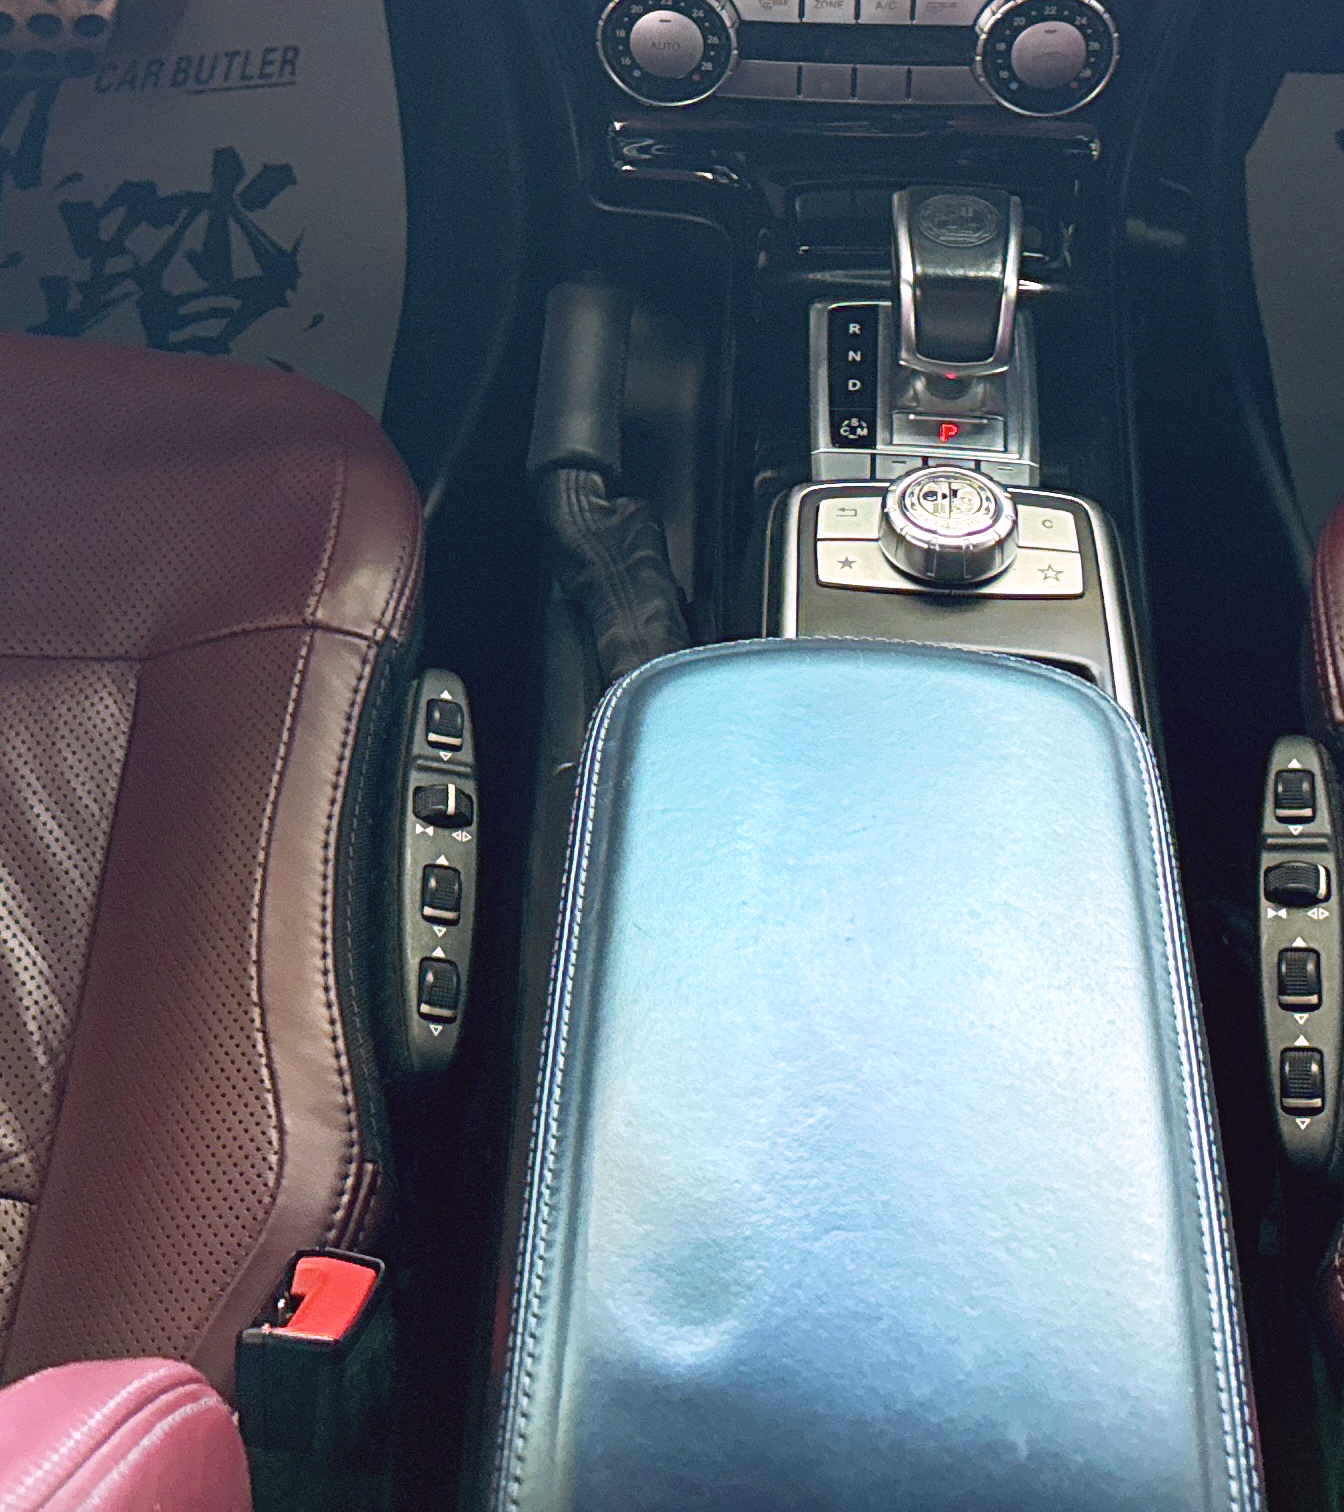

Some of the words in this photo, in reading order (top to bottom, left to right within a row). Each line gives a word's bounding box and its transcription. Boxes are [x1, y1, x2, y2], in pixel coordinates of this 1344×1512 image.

[630, 5, 643, 14] 20
[813, 0, 844, 10] ZONE
[874, 0, 898, 11] A/C
[691, 9, 705, 17] 24
[95, 58, 164, 93] CAR
[170, 44, 301, 91] BUTLER
[849, 323, 861, 335] R
[848, 350, 862, 362] N
[847, 379, 862, 392] D
[939, 423, 959, 443] P
[1041, 518, 1054, 529] C
